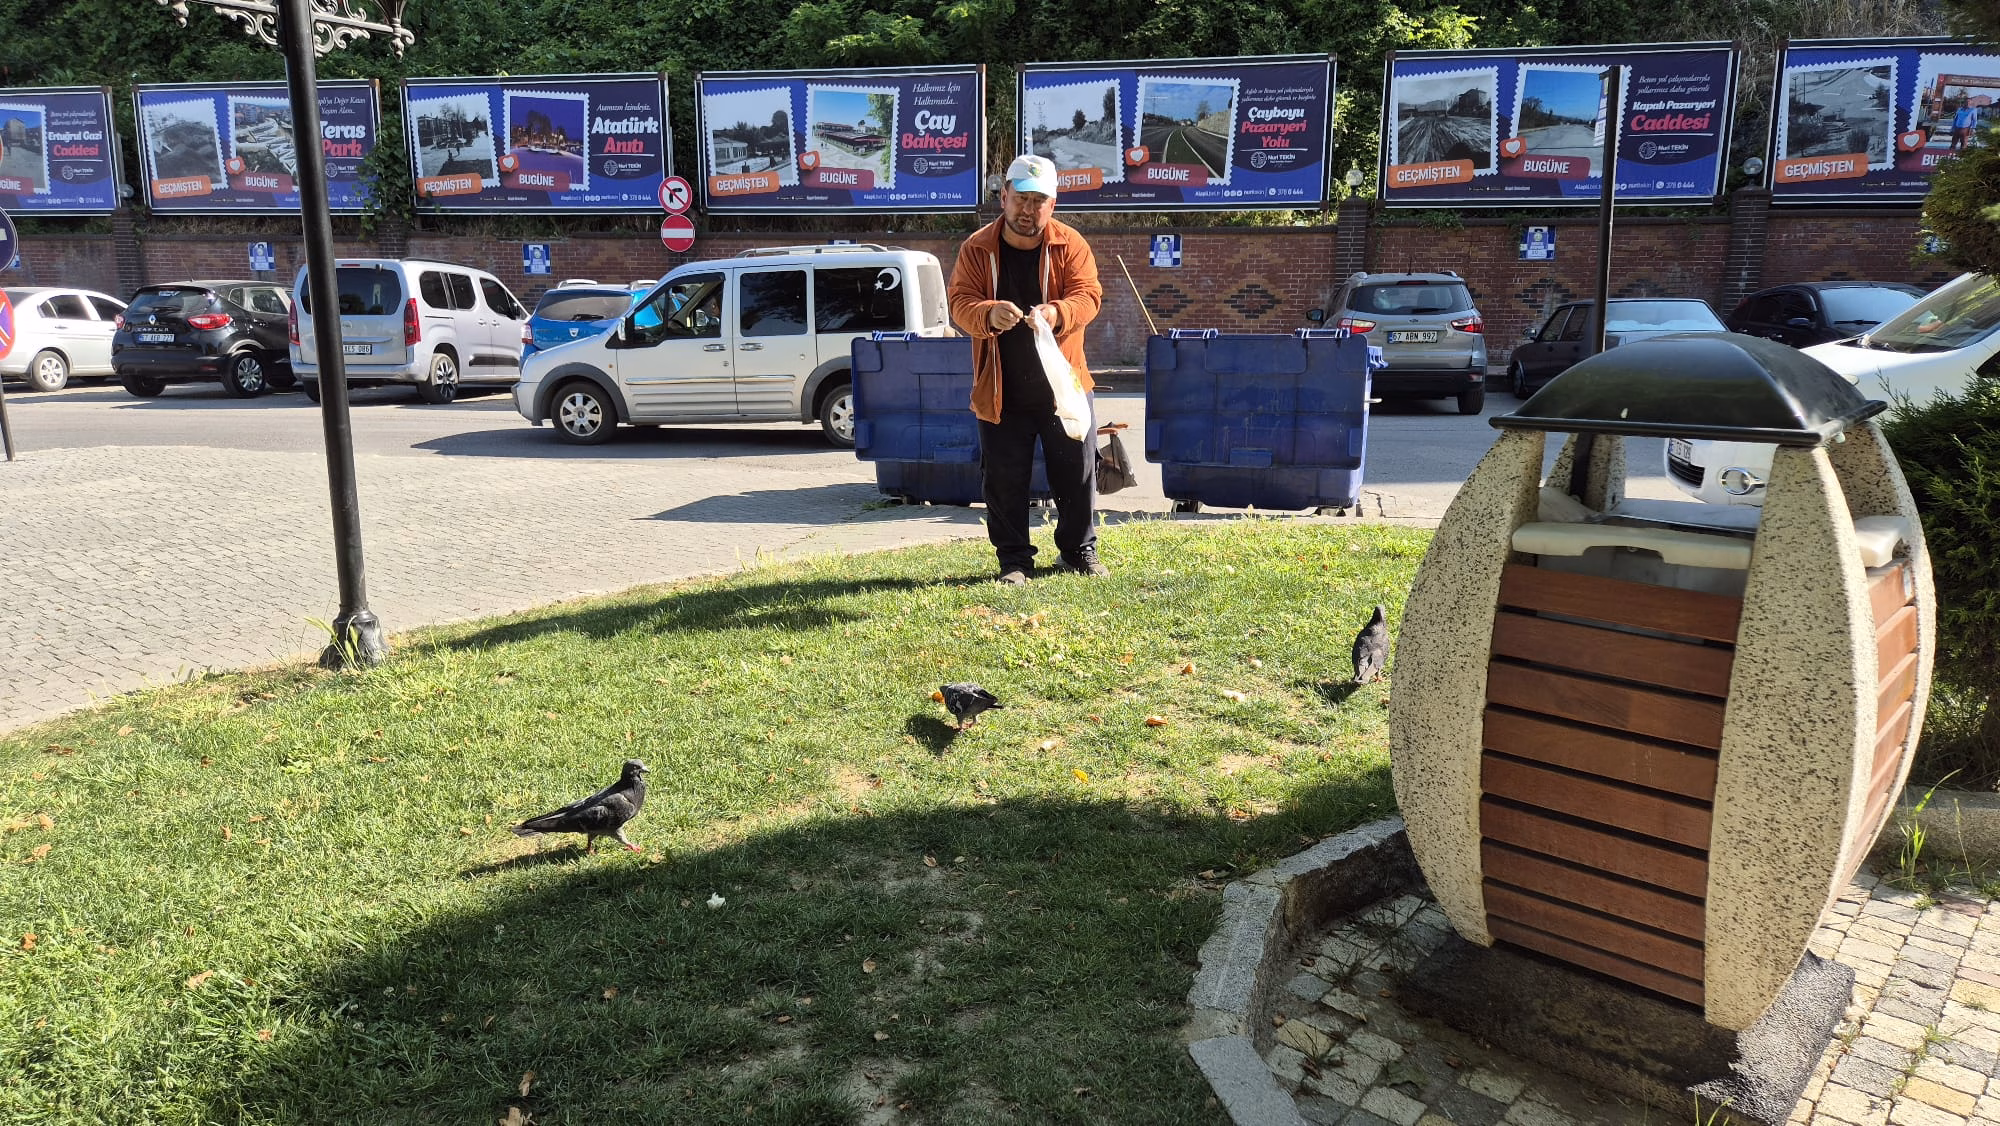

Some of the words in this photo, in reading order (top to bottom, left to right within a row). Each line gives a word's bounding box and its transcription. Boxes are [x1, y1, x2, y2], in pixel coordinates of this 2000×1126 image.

[912, 83, 946, 93] Halkımız
[947, 81, 961, 94] İçin
[1632, 100, 1666, 112] Kapalı
[1666, 99, 1717, 111] Pazaryeri
[1248, 106, 1305, 122] Çayboyu
[1630, 112, 1712, 131] Caddesi
[320, 120, 366, 139] Teras
[591, 116, 659, 134] Atatürk
[914, 110, 957, 136] Çay
[1241, 120, 1308, 135] Pazaryeri
[48, 131, 82, 143] Ertuğrul
[83, 130, 102, 140] Gazi
[901, 131, 969, 153] Bahçesi
[1261, 135, 1291, 148] Yolu
[53, 144, 99, 156] Caddesi
[321, 139, 363, 157] Park
[603, 136, 645, 154] Anıtı
[1147, 166, 1190, 182] BUGÜNE
[1396, 165, 1461, 184] GEÇMİŞTEN
[1523, 159, 1571, 175] BUGÜNE
[1784, 159, 1855, 179] GEÇMİŞTEN
[0, 178, 21, 191] GÜNE
[245, 175, 278, 188] BUGÜNE
[518, 172, 555, 187] BUGÜNE
[716, 176, 769, 193] GEÇMİŞTEN
[819, 170, 858, 185] BUGÜNE
[159, 180, 203, 195] GEÇMİŞTEN
[423, 178, 472, 193] GEÇMİŞTEN
[1392, 332, 1402, 341] 67
